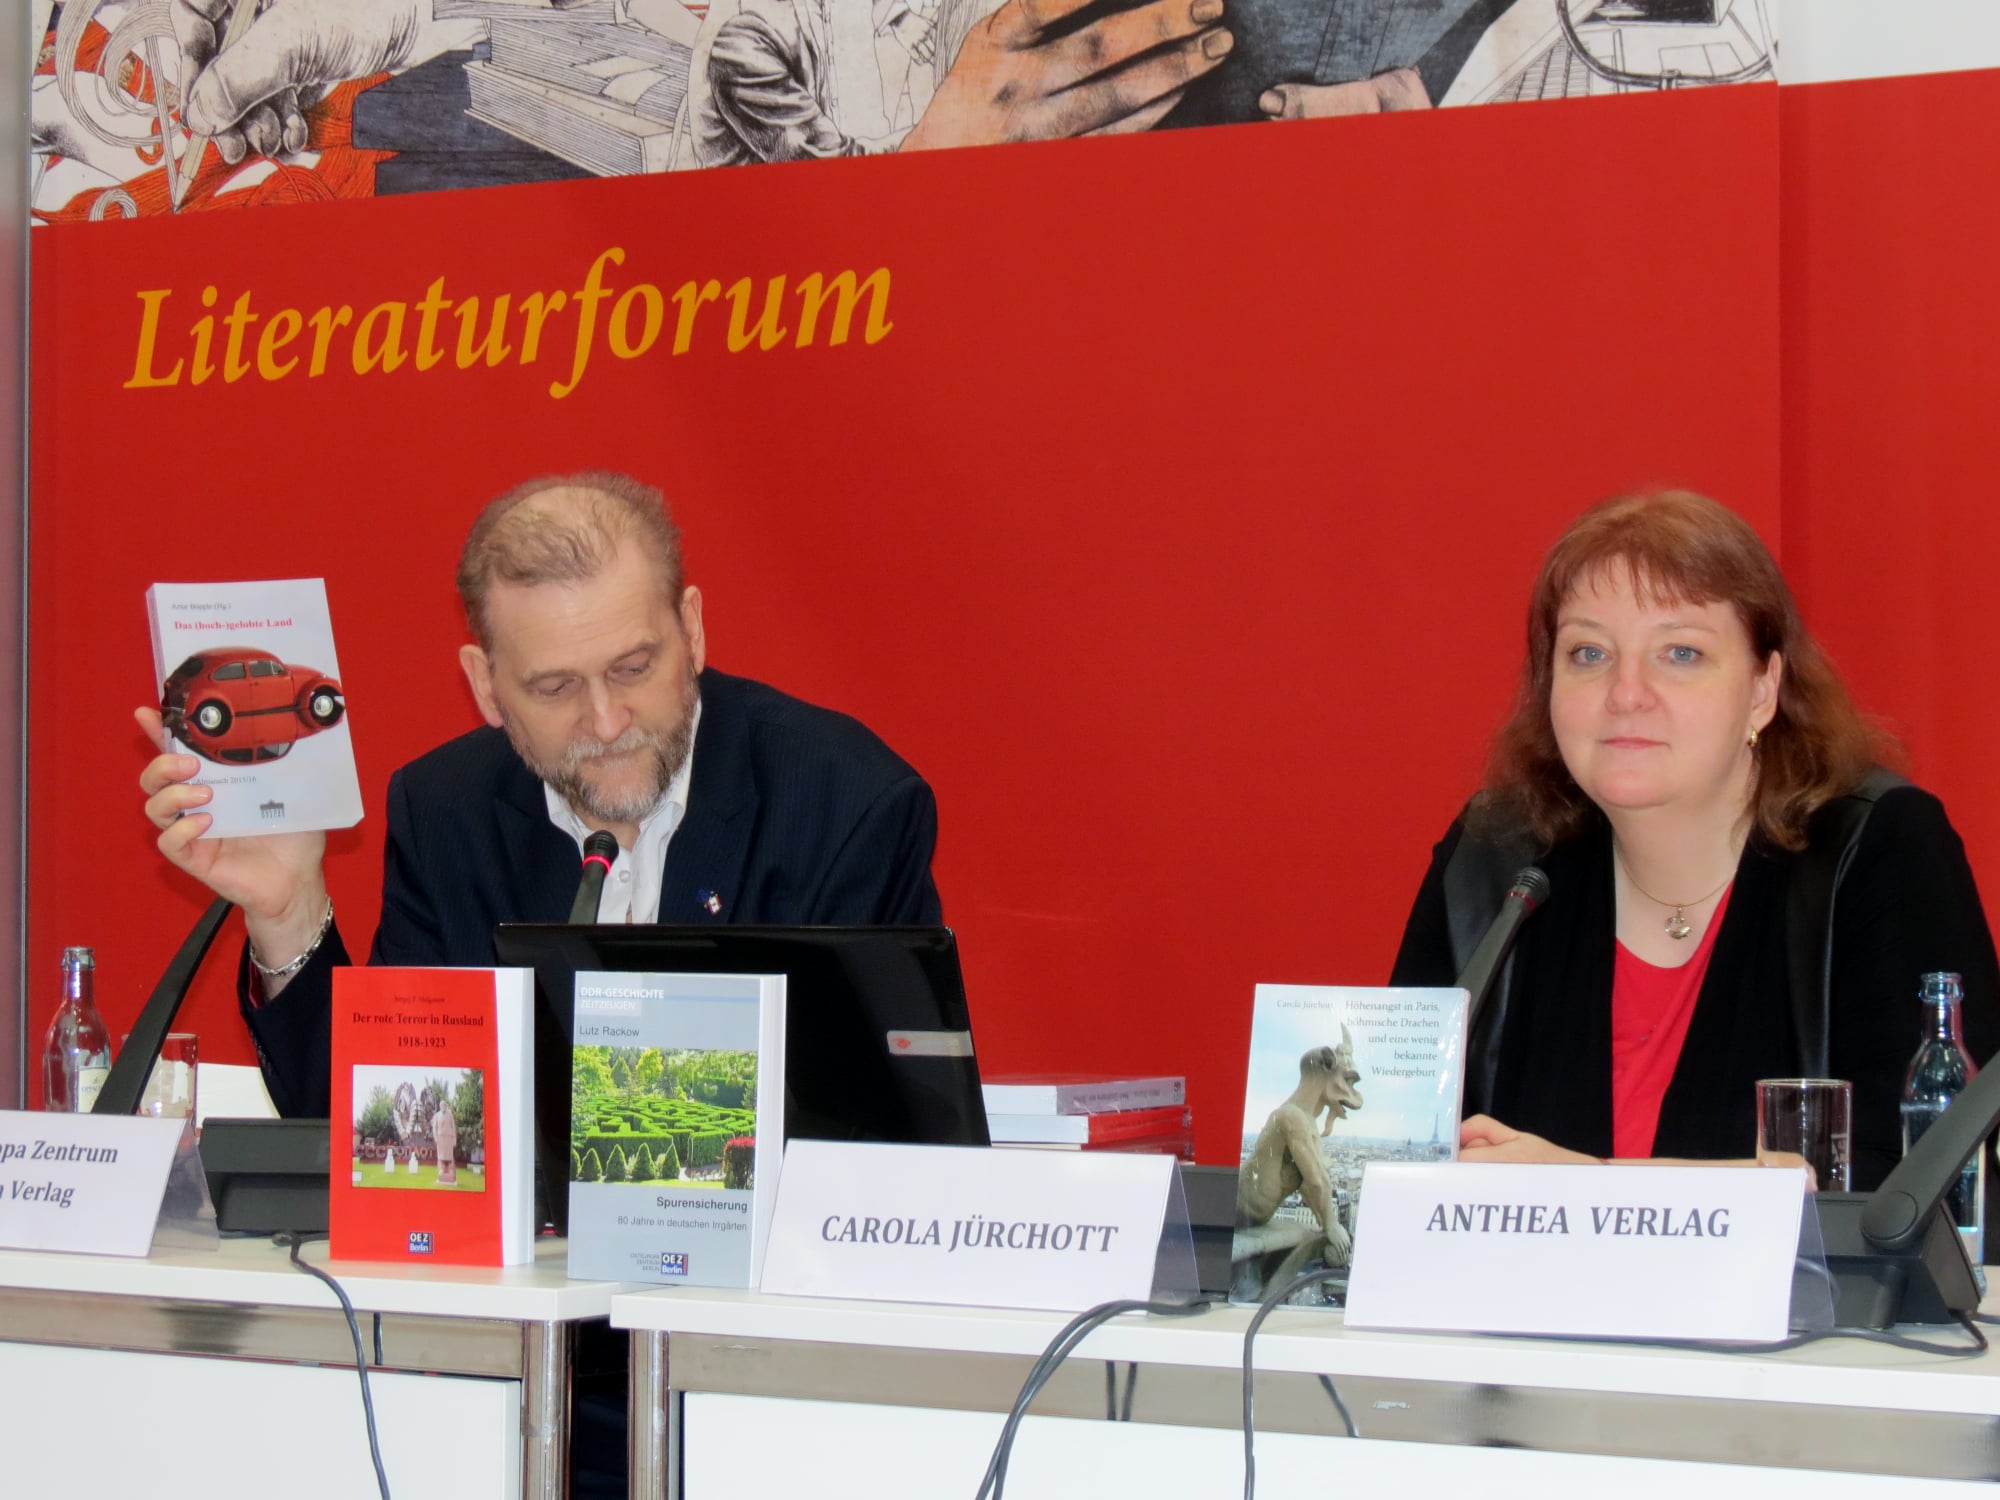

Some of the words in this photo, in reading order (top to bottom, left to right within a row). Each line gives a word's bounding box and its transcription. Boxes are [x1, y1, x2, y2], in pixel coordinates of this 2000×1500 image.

[123, 247, 894, 398] Literaturforum
[175, 621, 192, 630] Das
[266, 617, 293, 628] Land
[580, 986, 664, 999] DDR-GESCHICHTE
[580, 999, 635, 1010] ZEITZEUGEN
[1346, 1000, 1401, 1013] Höhenangst
[1404, 1000, 1413, 1011] in
[1415, 1001, 1440, 1013] Paris,
[353, 1012, 373, 1024] Der
[374, 1013, 394, 1024] rote
[397, 1013, 428, 1025] Terror
[431, 1013, 440, 1025] in
[442, 1014, 484, 1026] Russland
[1347, 1017, 1398, 1028] böhmische
[1400, 1018, 1439, 1028] Drachen
[580, 1025, 599, 1036] Lutz
[602, 1026, 640, 1037] Rackow
[398, 1036, 446, 1048] 1918-1923
[1368, 1034, 1387, 1044] und
[1389, 1034, 1408, 1044] eine
[1410, 1035, 1438, 1046] wenig
[1394, 1050, 1437, 1061] bekannte
[1371, 1065, 1436, 1079] Wiedergeburt
[0, 1143, 26, 1163] pa
[31, 1140, 118, 1163] Zentrum
[12, 1180, 75, 1208] Verlag
[657, 1196, 748, 1213] Spurensicherung
[617, 1216, 629, 1225] 80
[631, 1215, 654, 1226] Jahre
[657, 1216, 664, 1226] in
[667, 1218, 710, 1229] deutschen
[712, 1221, 747, 1232] Irrgärten
[1425, 1203, 1570, 1234] ANTHEA
[1590, 1206, 1730, 1237] VERLAG
[410, 1232, 429, 1242] OEZ
[821, 1215, 941, 1246] CAROLA
[948, 1214, 1119, 1252] JÜRCHOTT
[662, 1254, 683, 1264] OEZ
[662, 1264, 683, 1273] Berlin
